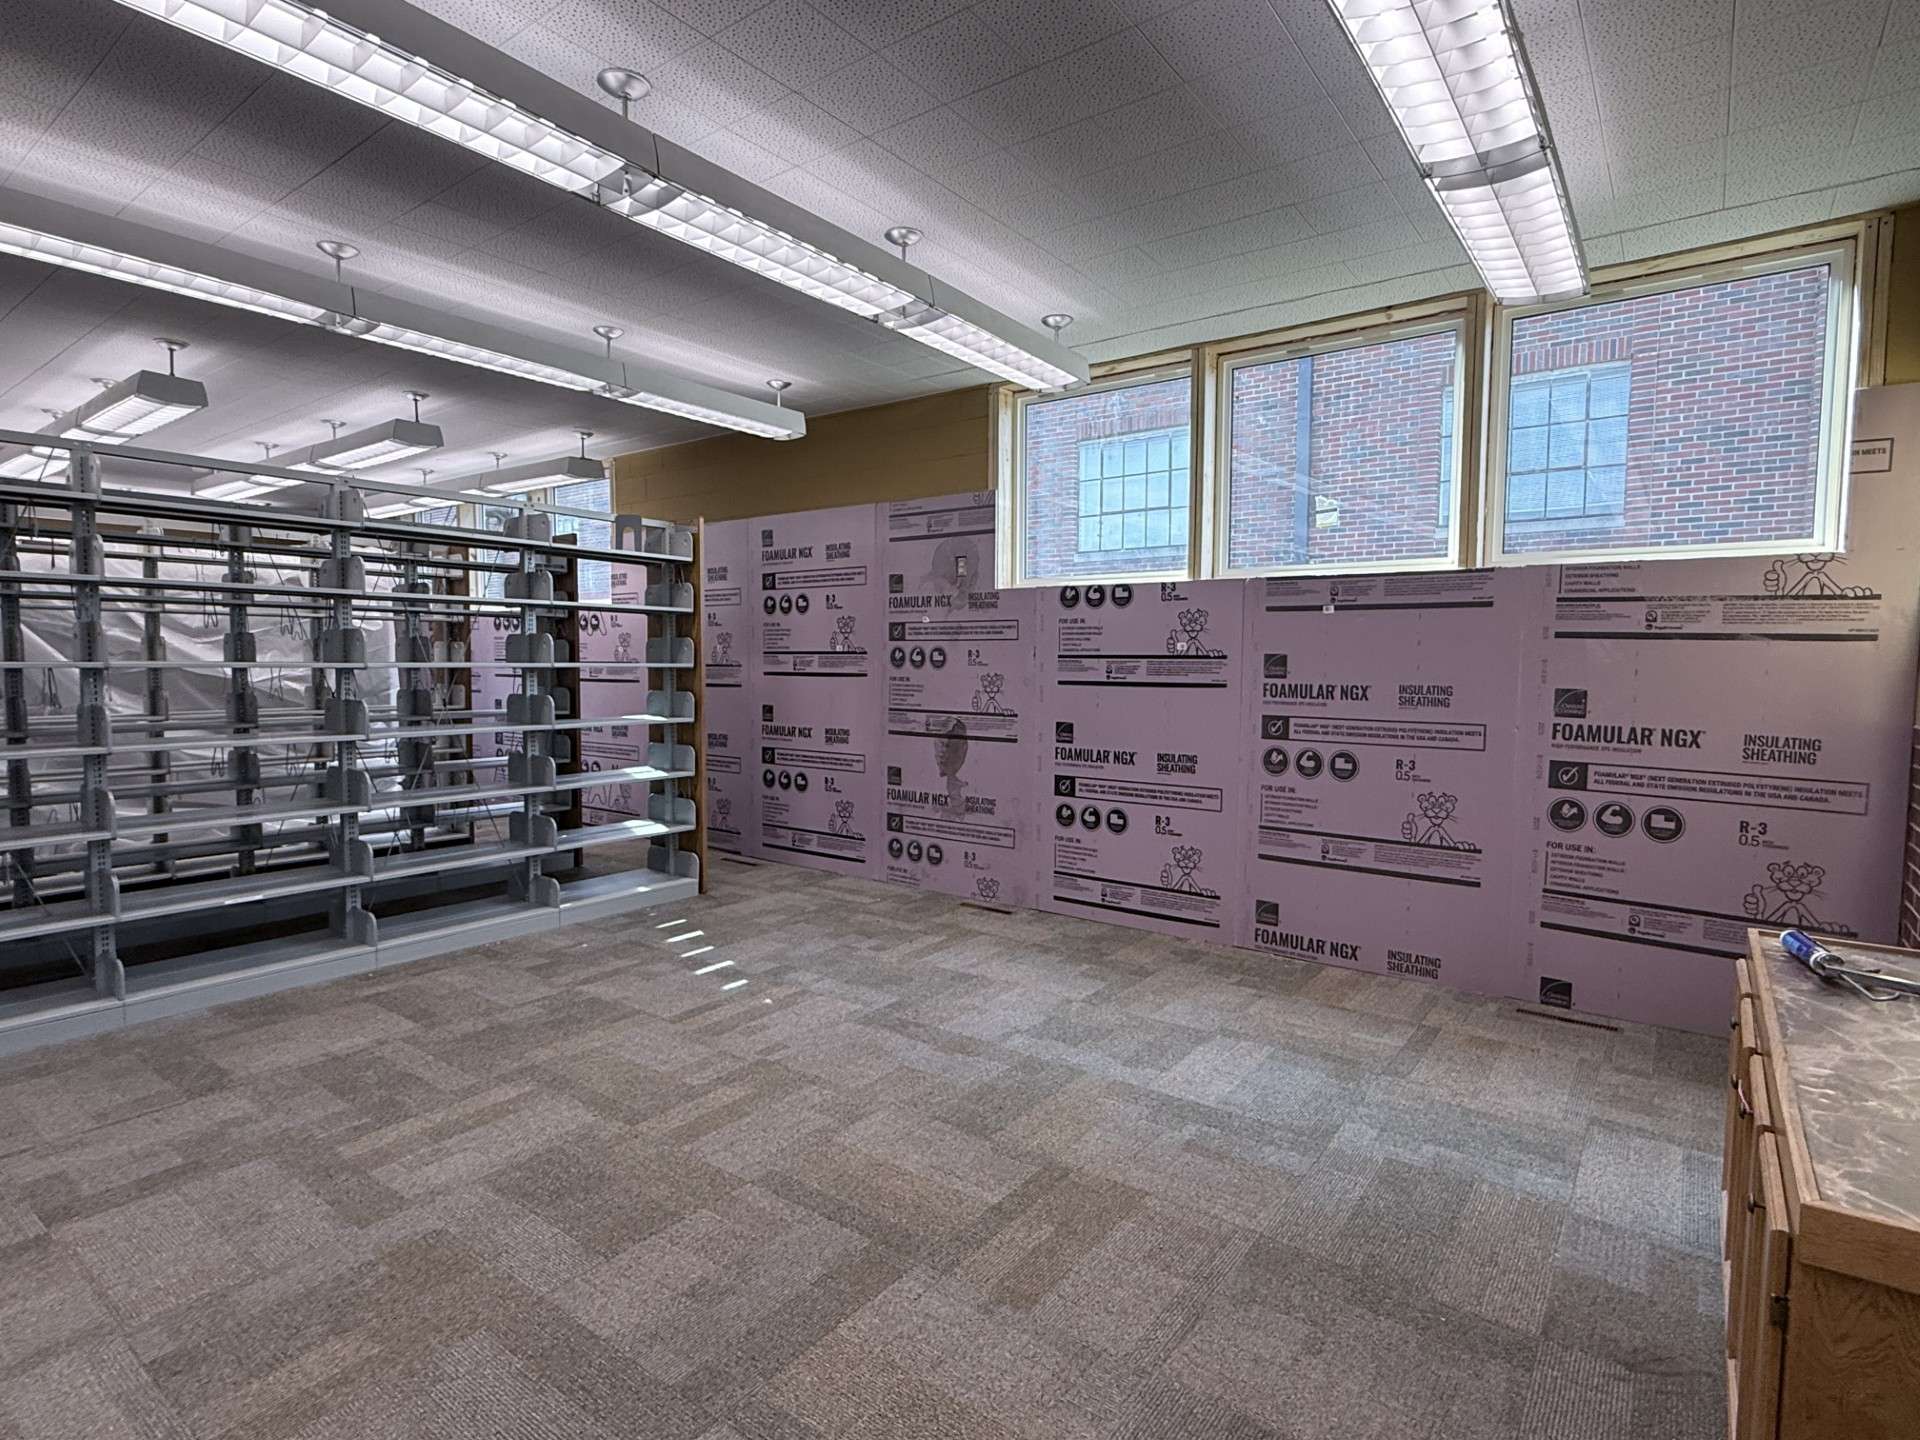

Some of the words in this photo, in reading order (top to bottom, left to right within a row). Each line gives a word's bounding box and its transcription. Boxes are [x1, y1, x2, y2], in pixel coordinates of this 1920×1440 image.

[762, 548, 797, 561] FOAMULAR
[888, 595, 932, 609] FOAMULAR
[934, 594, 952, 608] NGX
[1262, 682, 1335, 700] FOAMULAR
[1340, 684, 1369, 701] NGX
[1398, 684, 1453, 697] INSULATING
[1398, 695, 1450, 708] SHEATHING
[762, 724, 796, 737] FOAMULAR
[798, 727, 812, 738] NGX
[1552, 722, 1654, 747] FOAMULAR
[1660, 727, 1702, 749] NGX
[1743, 734, 1822, 751] INSULATING
[1055, 746, 1110, 764] FOAMULAR
[1113, 750, 1136, 766] NGX
[1156, 753, 1198, 764] INSULATING
[1742, 747, 1817, 765] SHEATHING
[1156, 763, 1196, 774] SHEATHING
[1396, 759, 1416, 771] R-3
[887, 788, 930, 804] FOAMULAR
[931, 792, 950, 806] NGX
[1155, 815, 1170, 826] R-3
[1739, 820, 1768, 835] R-3
[1546, 841, 1564, 850] FOR
[1565, 844, 1582, 853] USE
[1738, 834, 1761, 847] 0.5
[1255, 928, 1326, 955] FOAMULAR
[1330, 941, 1360, 962] NGX
[1387, 949, 1442, 969] INSULATING
[1386, 961, 1439, 980] SHEATHING
